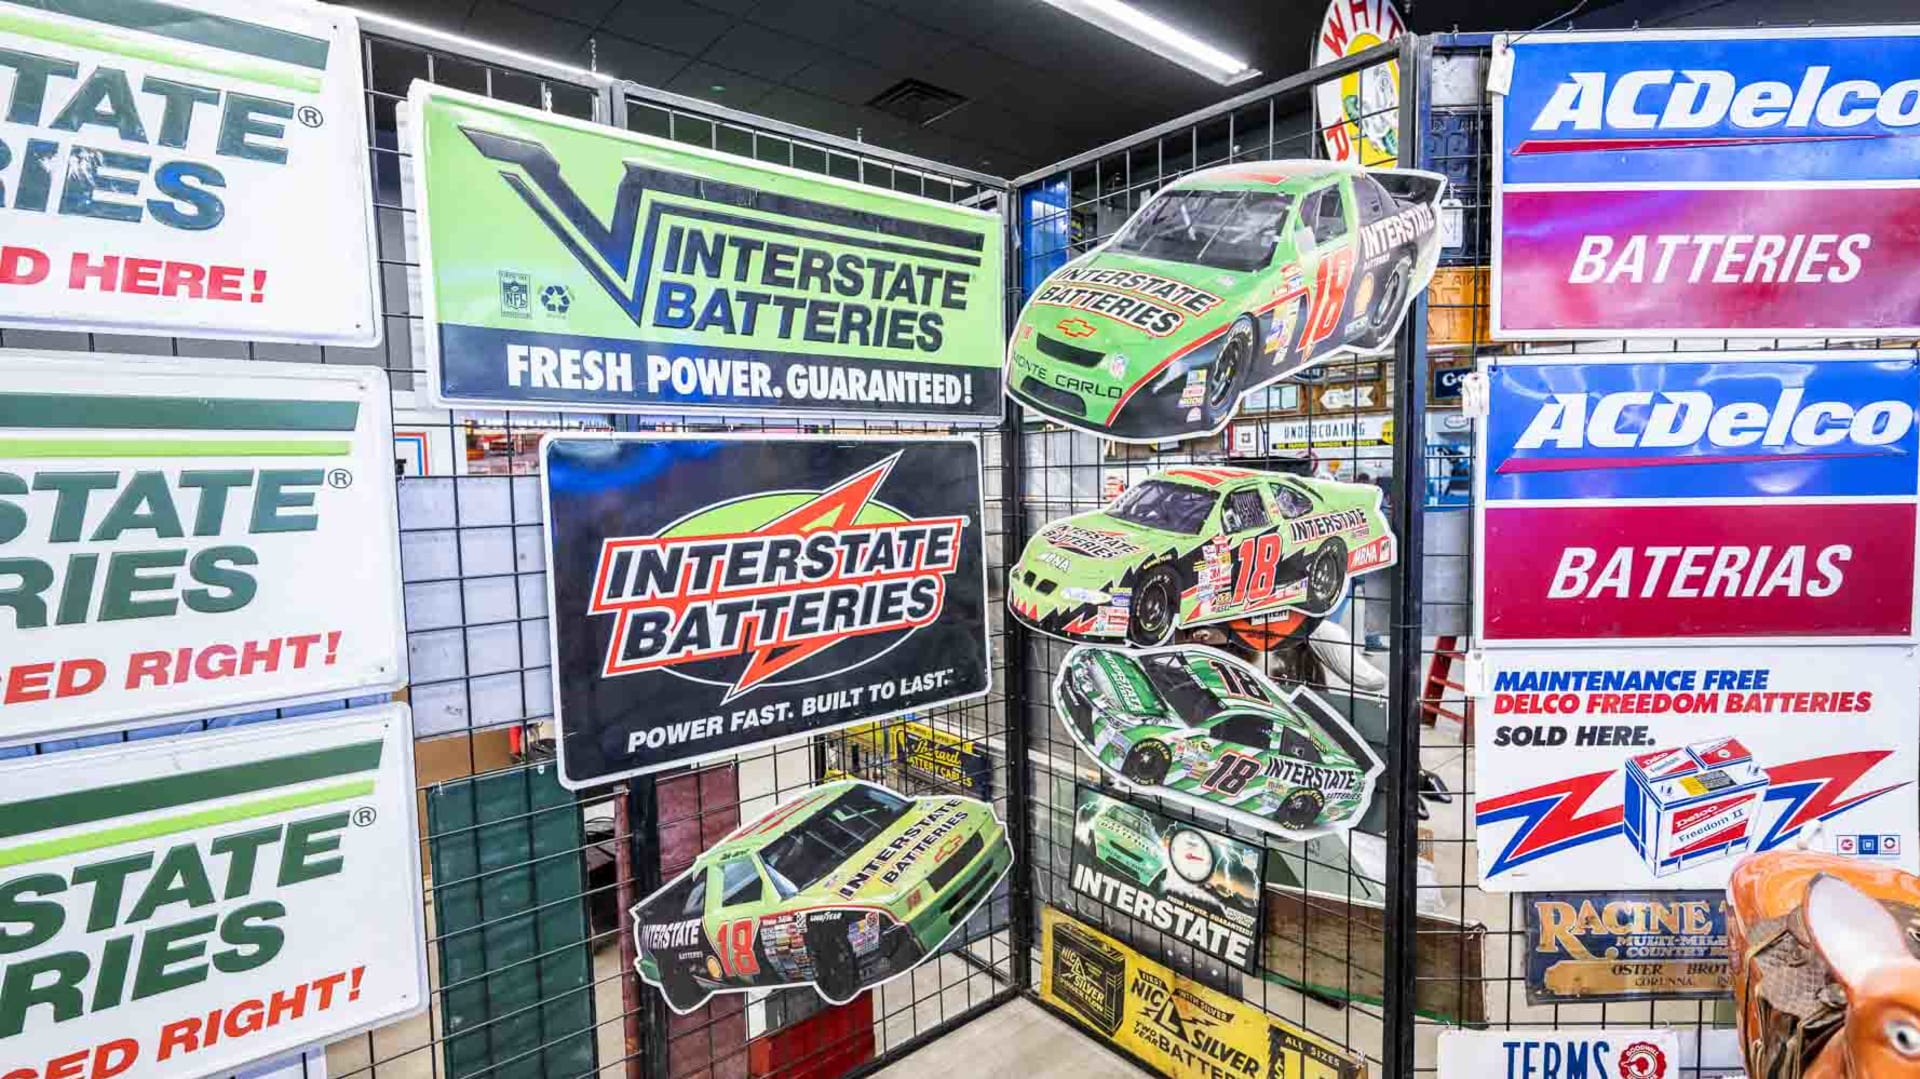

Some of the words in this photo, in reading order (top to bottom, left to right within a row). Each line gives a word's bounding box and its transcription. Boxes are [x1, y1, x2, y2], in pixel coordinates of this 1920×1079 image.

[1530, 66, 1920, 131] ACDelco
[0, 138, 227, 231] IES
[68, 252, 267, 303] HERE!
[664, 225, 970, 311] INTERSTATE
[1567, 233, 1872, 284] BATTERIES
[506, 292, 527, 308] NFL
[1038, 286, 1181, 333] BATTERIES
[1064, 268, 1215, 313] INTERSTATE
[1296, 249, 1353, 352] 18
[652, 281, 943, 354] BATTERIES
[506, 344, 633, 394] FRESH
[646, 354, 783, 399] POWER.
[786, 367, 974, 406] GUARANTEED!
[1055, 374, 1123, 399] CARLO
[1513, 387, 1914, 449] ACDelco
[1290, 508, 1368, 542] INTERSTATE
[606, 526, 956, 600] INTERSTATE
[1232, 533, 1283, 606] 18
[1546, 544, 1854, 600] BATERIAS
[620, 575, 941, 662] BATTERIES
[124, 630, 342, 690] RIGHT!
[1209, 659, 1273, 707] 18
[1494, 670, 1696, 692] MAINTENANCE
[1702, 669, 1770, 691] FREE
[627, 715, 723, 753] POWER
[729, 703, 794, 733] FAST.
[802, 686, 864, 715] BUILT
[868, 681, 896, 702] TO
[1493, 693, 1582, 715] DELCO
[1585, 692, 1720, 714] FREEDOM
[1725, 690, 1872, 713] BATTERIES
[1494, 725, 1568, 747] SOLD
[1575, 725, 1656, 746] HERE.
[1201, 751, 1262, 797] 18
[1264, 756, 1356, 790] INTERSTATE
[1675, 805, 1718, 827] Delco
[1678, 816, 1729, 842] Freedom
[838, 799, 962, 899] INTERSTATE
[881, 811, 969, 886] BATTERIES
[642, 918, 701, 950] INTERSTATE
[1073, 864, 1252, 967] INTERSTATE
[1535, 899, 1713, 960] RACINE
[716, 918, 760, 977] 18
[1612, 963, 1663, 975] OSTER
[156, 965, 366, 1062] RIGHT!
[1073, 975, 1105, 1003] SILVER
[1131, 977, 1164, 1007] NIC
[1190, 1029, 1261, 1079] SILVER
[1134, 1029, 1159, 1047] YEAR
[1135, 1020, 1157, 1037] TWO
[1284, 1036, 1304, 1050] ALL
[1312, 1047, 1340, 1067] SIZES
[1502, 1041, 1610, 1079] TERMS
